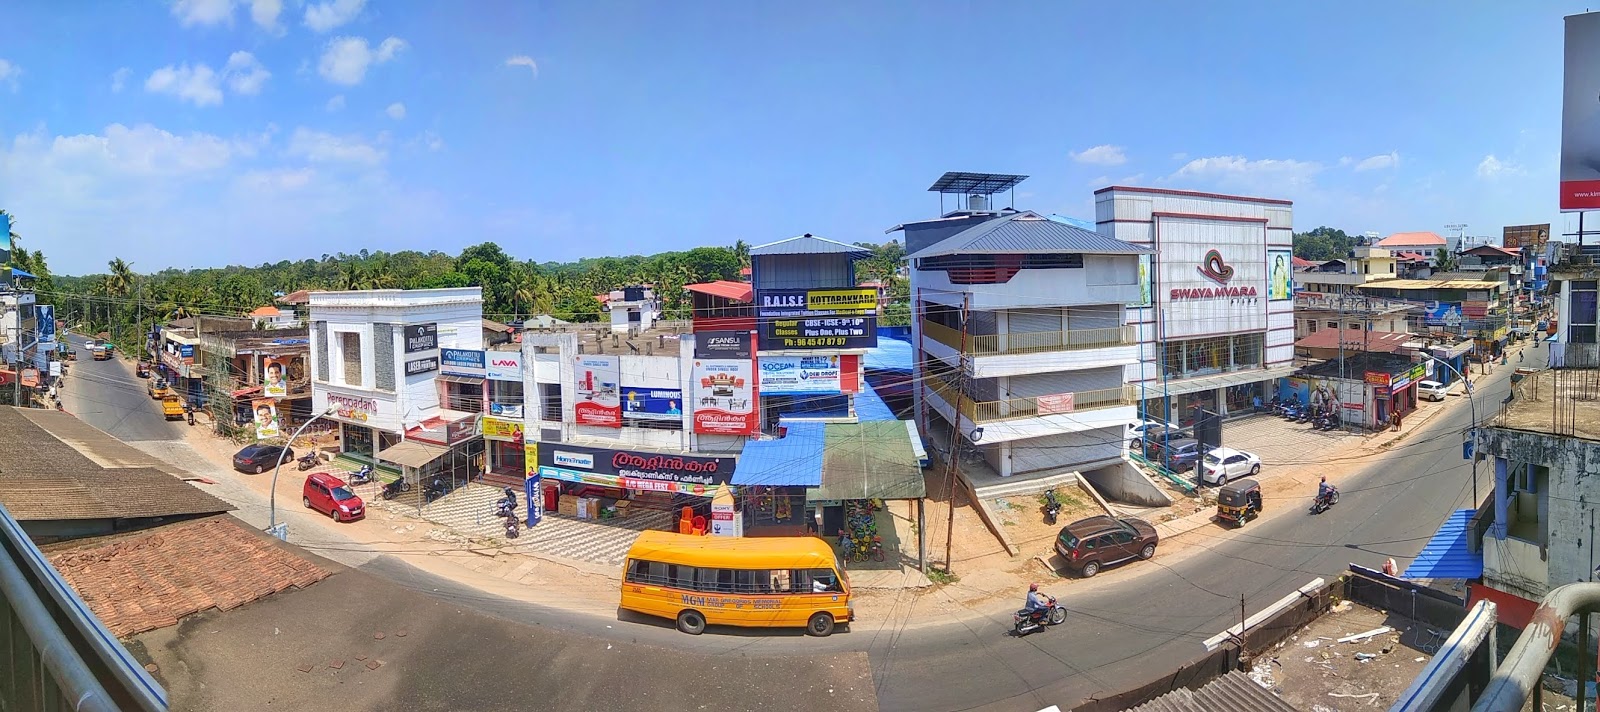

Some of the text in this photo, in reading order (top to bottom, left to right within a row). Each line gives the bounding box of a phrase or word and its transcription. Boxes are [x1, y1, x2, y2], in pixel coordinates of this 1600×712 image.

[1171, 286, 1257, 299] SWAYAMVARA
[764, 295, 804, 306] R.A.I.S.E
[810, 294, 875, 305] KOTTARAKKARA
[785, 338, 793, 346] Ph
[807, 338, 816, 346] 45
[817, 338, 826, 346] 47
[492, 359, 518, 367] LAVA
[651, 390, 681, 399] LUMINOUS
[637, 481, 653, 489] MEGA
[654, 482, 669, 490] FEST
[682, 594, 705, 606] MGM
